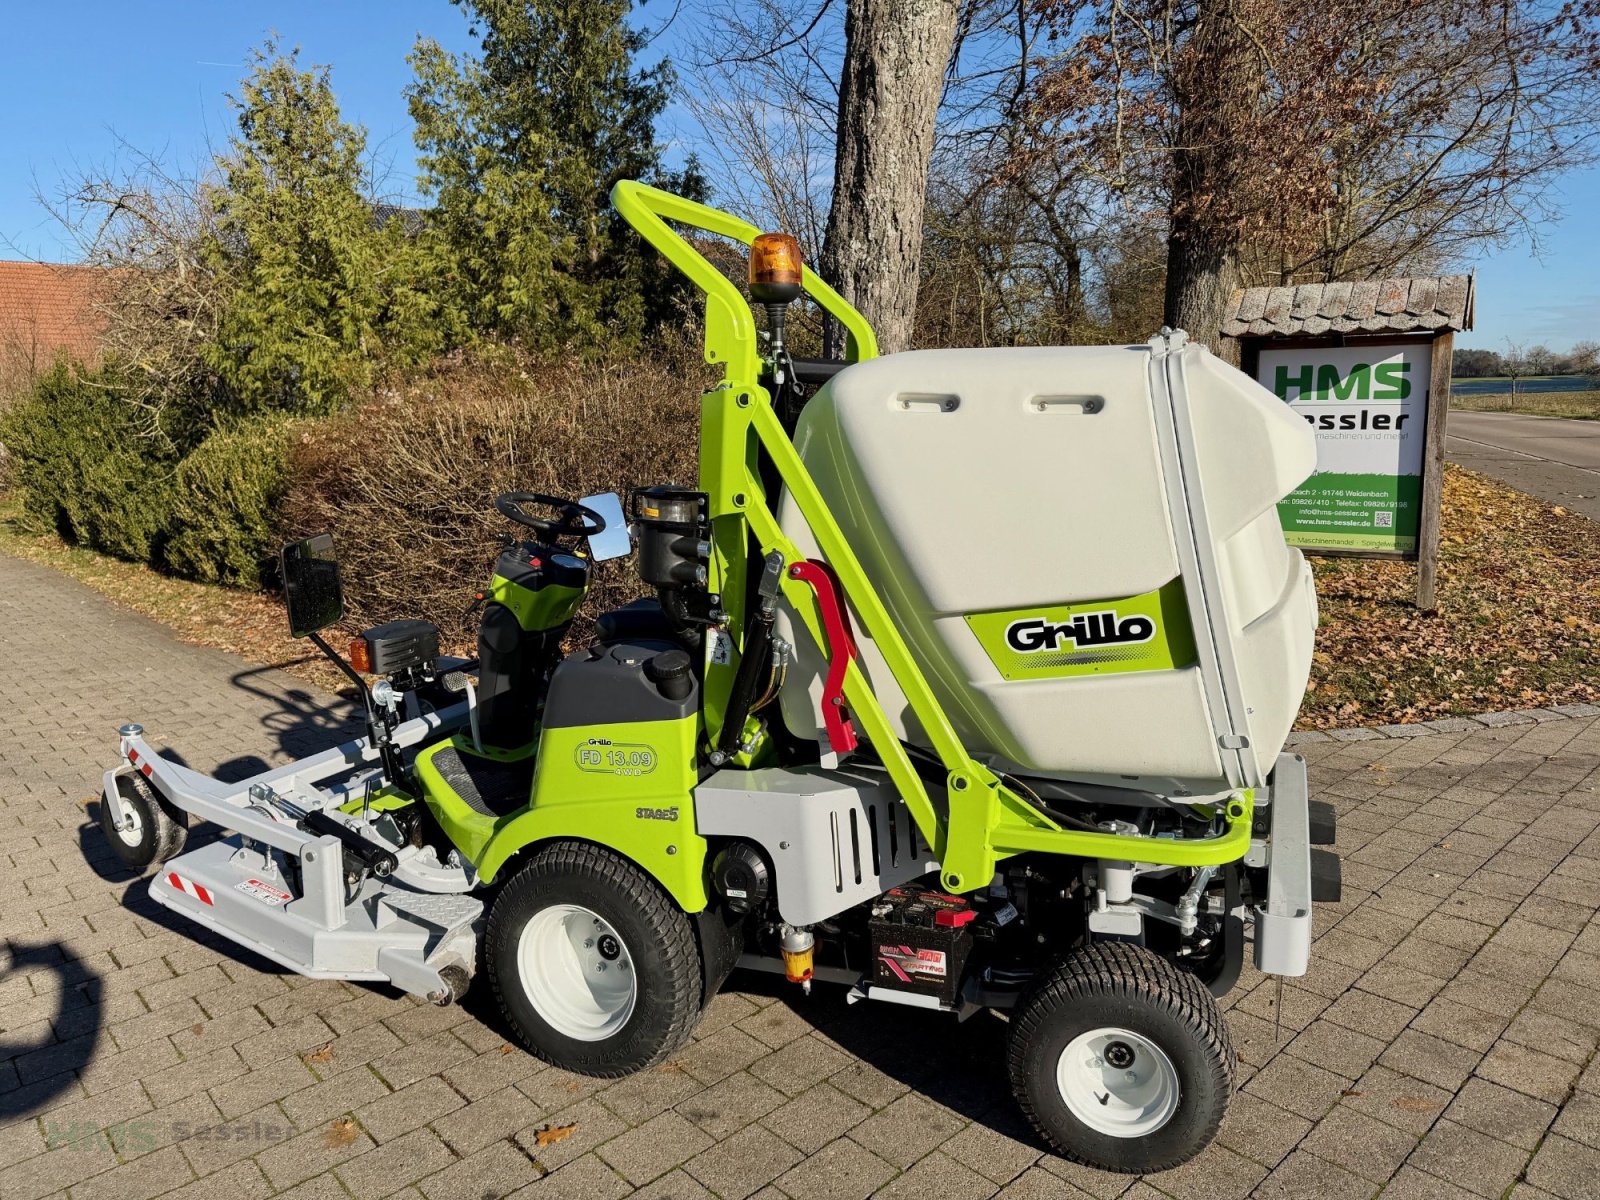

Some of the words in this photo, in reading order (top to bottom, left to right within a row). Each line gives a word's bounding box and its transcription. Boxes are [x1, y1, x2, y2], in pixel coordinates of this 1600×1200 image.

[1275, 362, 1411, 401] HMS
[1365, 432, 1380, 440] und
[1322, 489, 1344, 497] 91746
[1335, 499, 1362, 507] Telefax:
[1298, 508, 1369, 517] info@hms-sessler.de
[1295, 518, 1371, 527] www.hms-sessler.de
[1006, 611, 1155, 653] Grillo
[588, 738, 612, 746] Grillo
[580, 750, 602, 765] FD
[606, 751, 653, 767] 13.09
